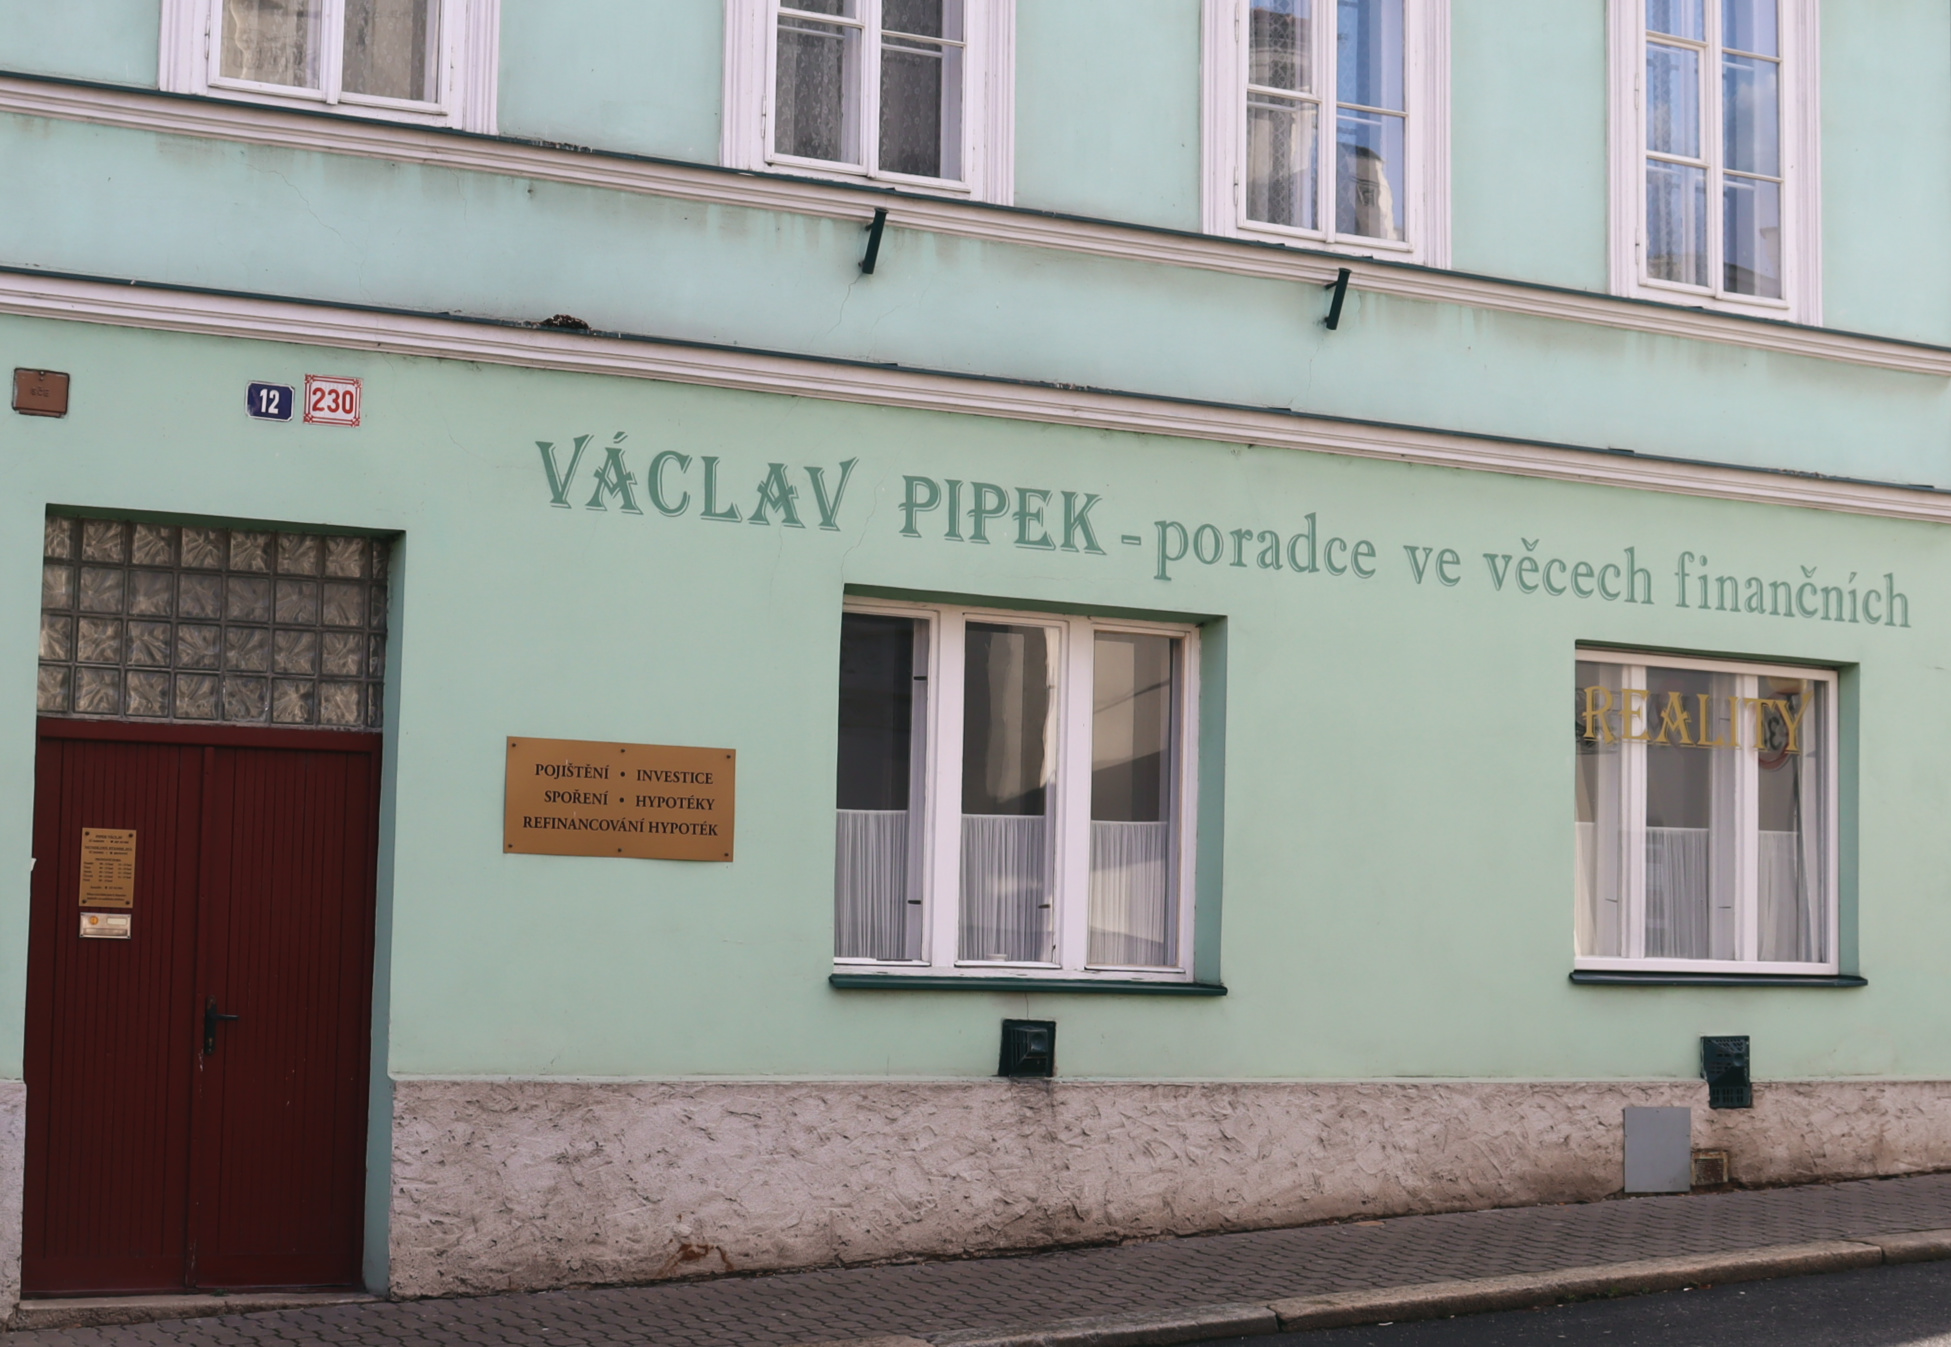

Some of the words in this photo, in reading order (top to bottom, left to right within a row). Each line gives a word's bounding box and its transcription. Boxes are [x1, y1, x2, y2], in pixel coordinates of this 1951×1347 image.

[260, 388, 280, 414] 12
[312, 387, 354, 414] 230
[535, 431, 859, 532] VÁCLAV
[899, 475, 1107, 555] PIPEK
[1153, 512, 1377, 581] poradce
[1403, 544, 1461, 587] ve
[1483, 537, 1655, 605] věcech
[1674, 551, 1912, 629] finančních
[1581, 685, 1814, 754] REALITY
[535, 763, 609, 780] POJIŠTĚNÍ
[636, 769, 713, 785] INVESTICE
[544, 789, 608, 805] SPOŘENÍ
[635, 795, 715, 811] HYPOTÉKY
[523, 815, 644, 833] REFINANCOVÁNÍ
[648, 820, 718, 836] HYPOTÉK
